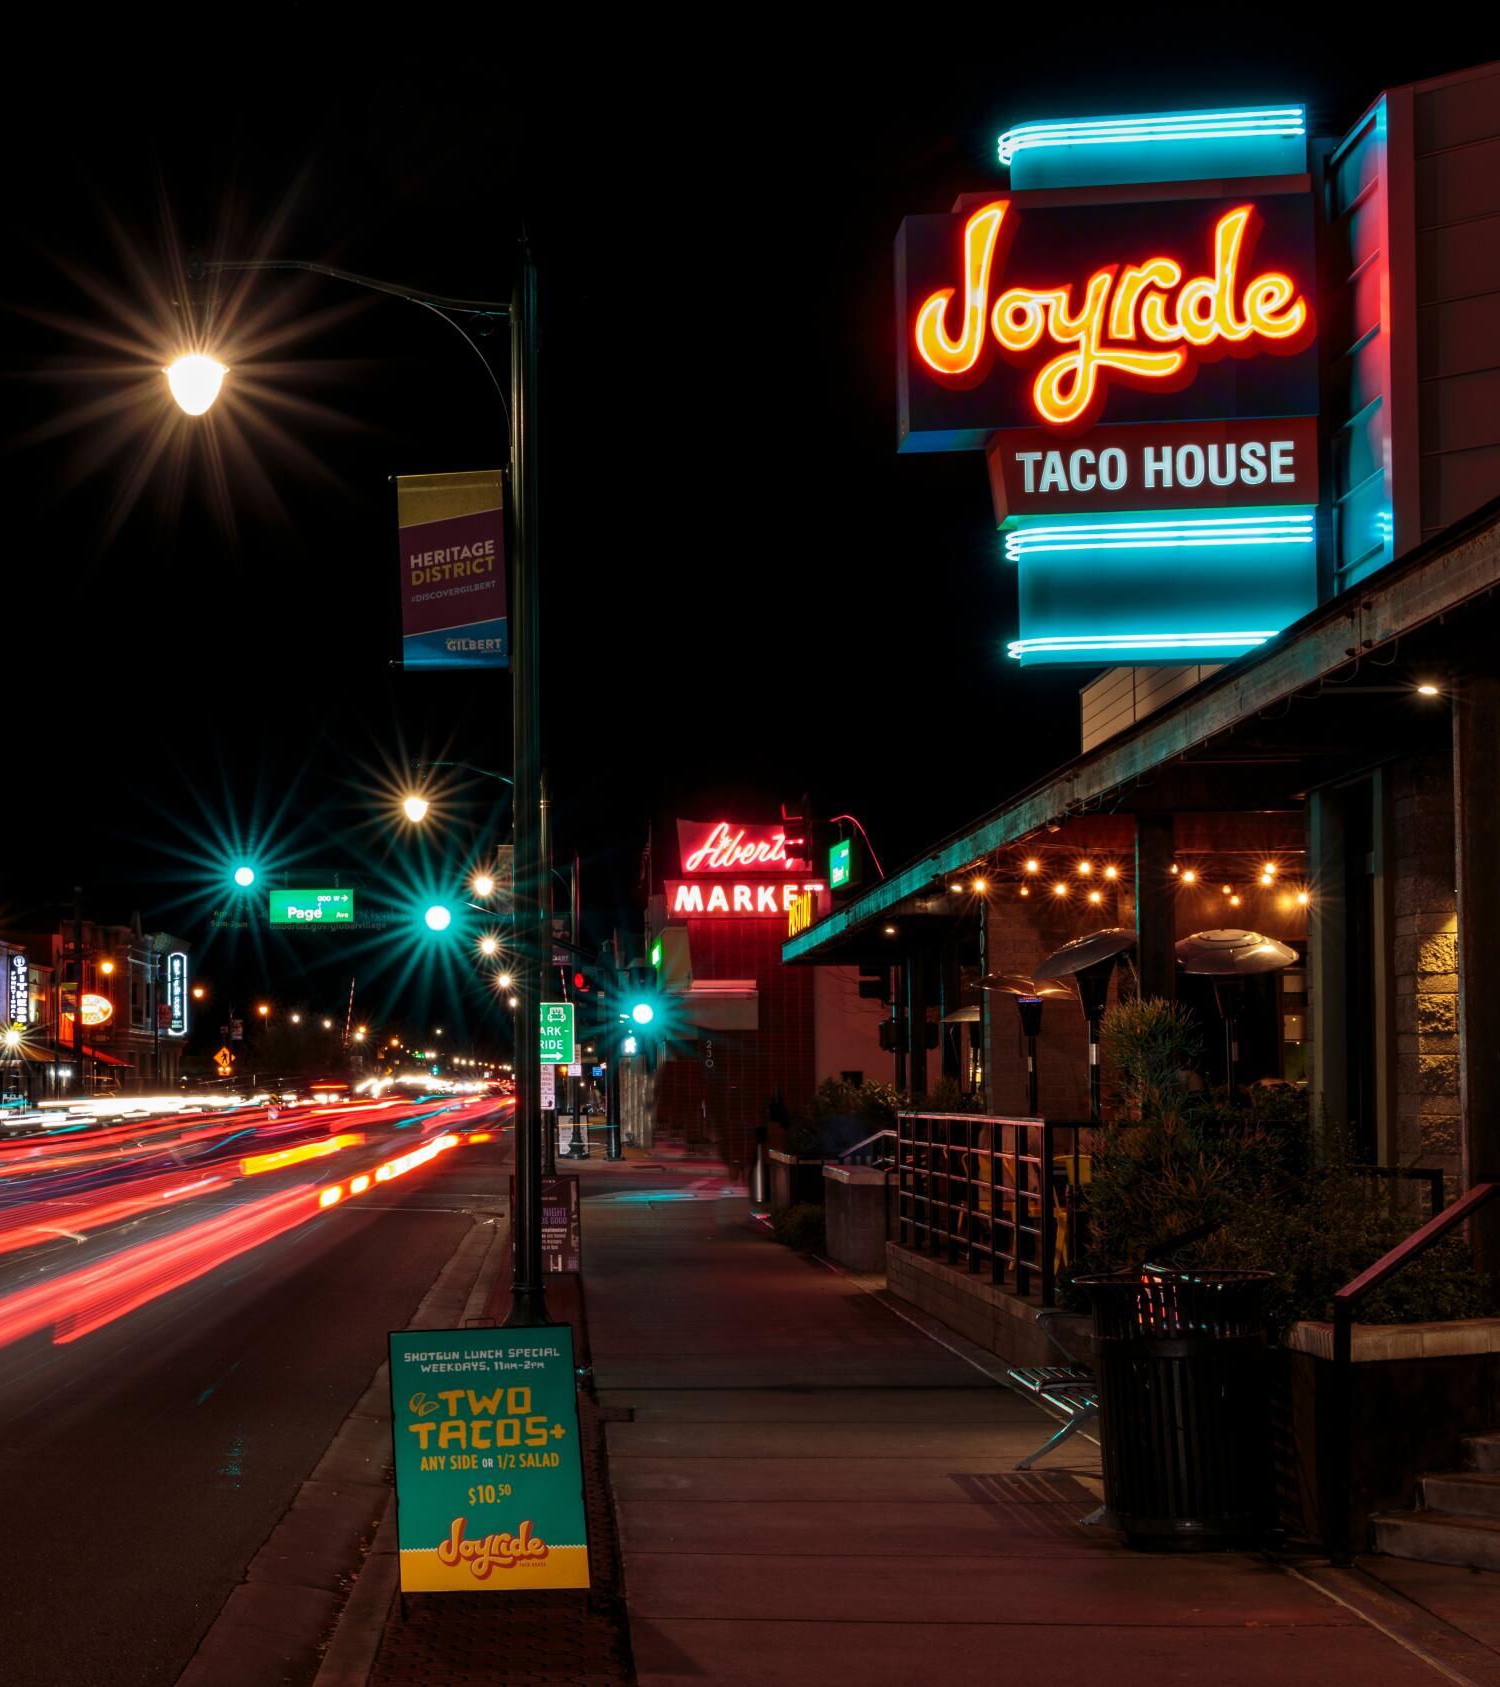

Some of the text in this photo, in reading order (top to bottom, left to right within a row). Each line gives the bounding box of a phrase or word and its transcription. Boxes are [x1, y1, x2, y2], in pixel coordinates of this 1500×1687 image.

[915, 199, 1307, 425] Joyride
[1016, 441, 1296, 494] TACO HOUSE
[410, 540, 495, 569] HERITAGE
[411, 556, 496, 587] DISTRICT
[411, 580, 497, 603] #DISCOVERGILBERT
[446, 638, 502, 652] GILBERT
[685, 822, 794, 871] Libert
[287, 906, 322, 921] Page
[16, 966, 28, 1023] FITNESS
[540, 1026, 561, 1036] ARK
[404, 1347, 560, 1362] SHOTGUN LUNCH SPECIAL
[437, 1387, 532, 1417] TWO
[408, 1416, 566, 1450] TACOS+
[420, 1452, 560, 1471] ANY SIDE OR 1/2 SALAD
[438, 1516, 549, 1580] Joyride
